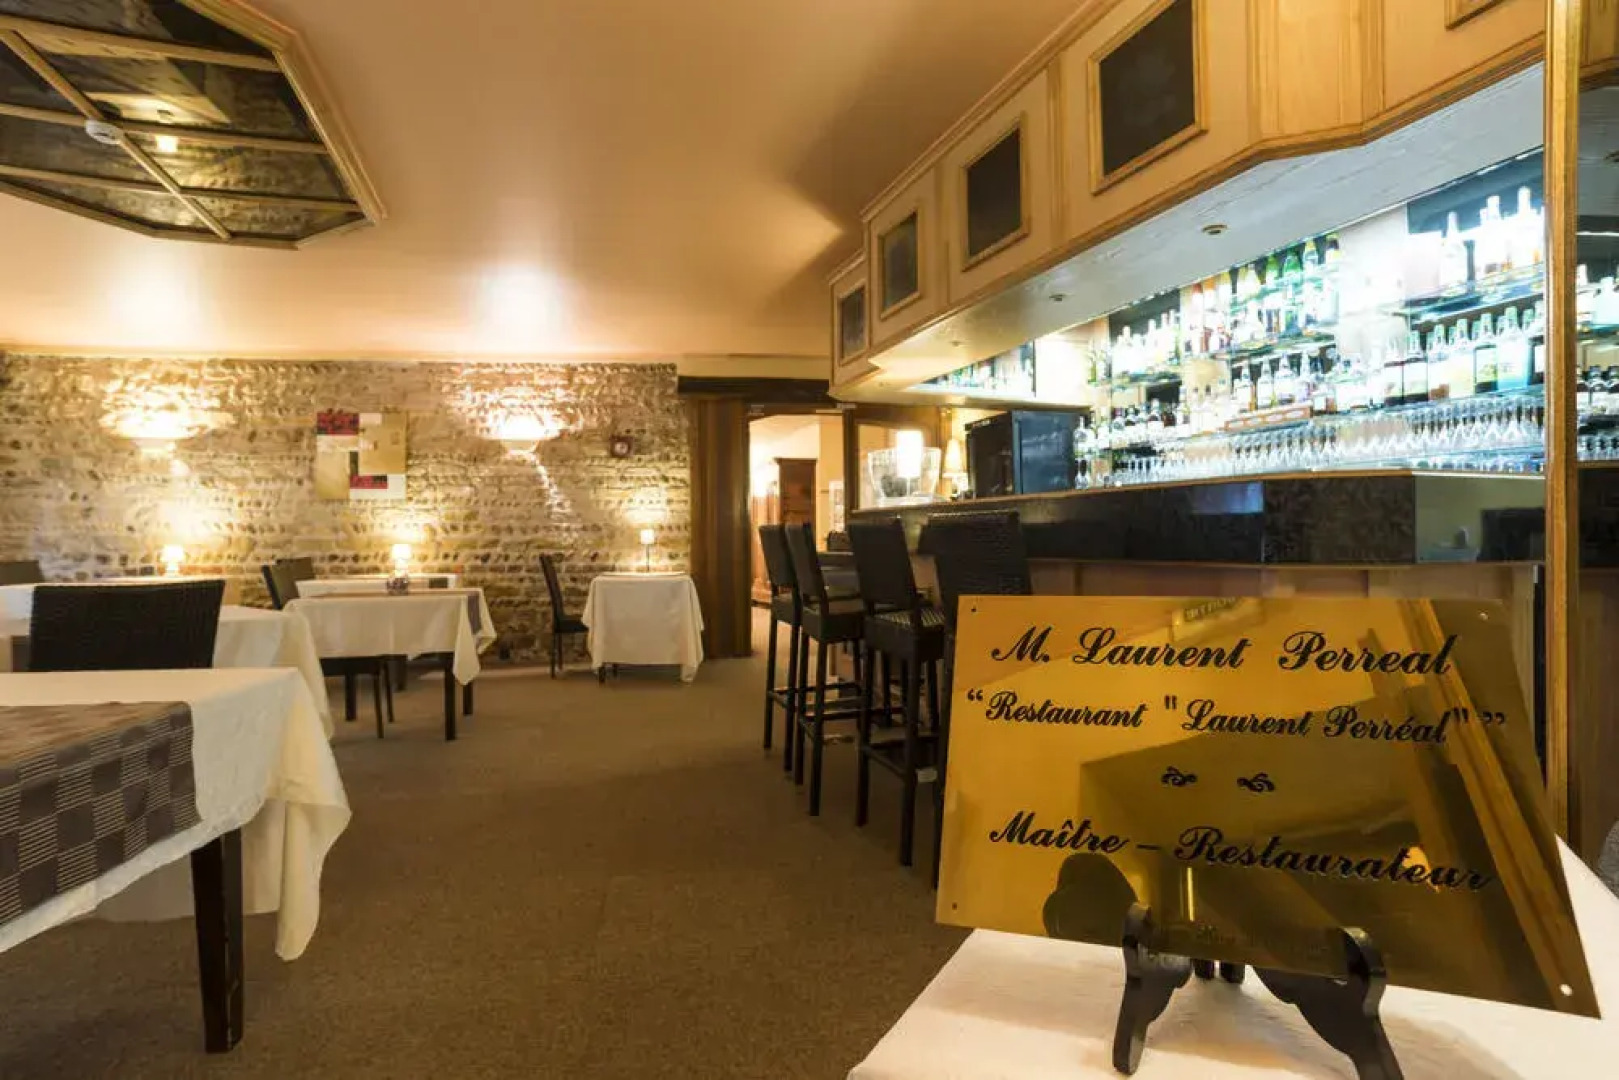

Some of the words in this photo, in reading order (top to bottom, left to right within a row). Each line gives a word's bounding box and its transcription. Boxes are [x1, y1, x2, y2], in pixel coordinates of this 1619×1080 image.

[991, 626, 1051, 662] M.
[1072, 628, 1251, 668] Laurent
[1278, 632, 1458, 675] Perreal
[989, 811, 1129, 853] Maître
[1174, 827, 1492, 890] Restaurateur
